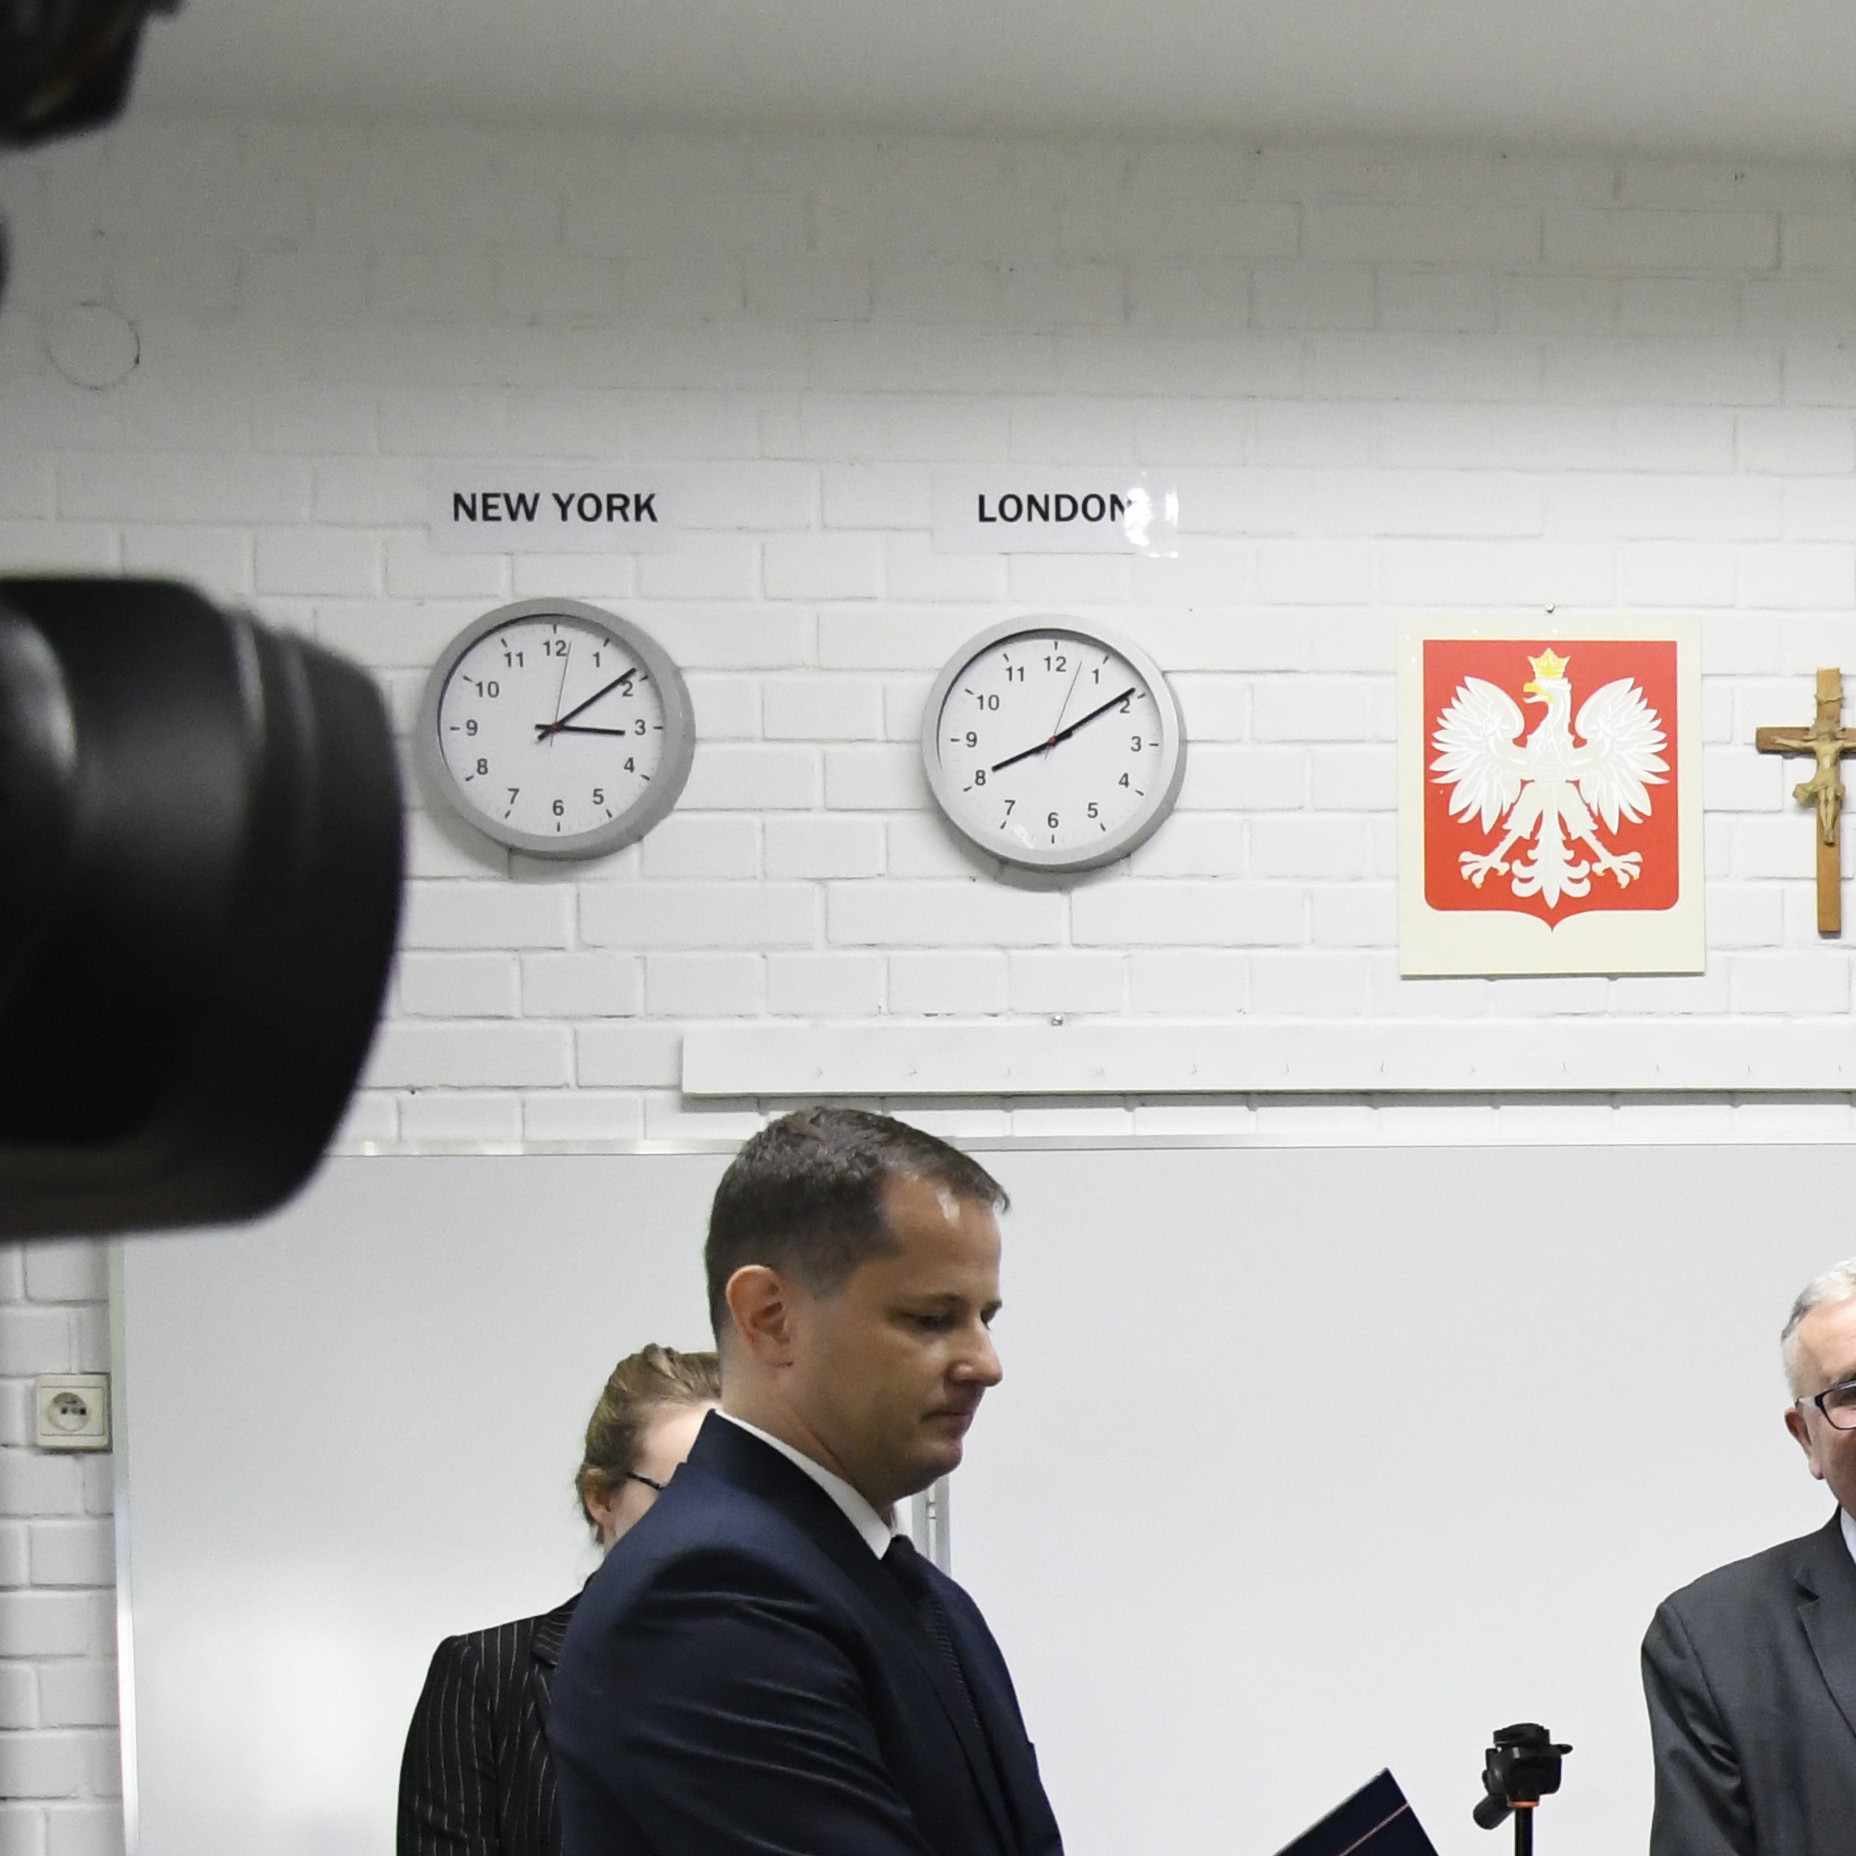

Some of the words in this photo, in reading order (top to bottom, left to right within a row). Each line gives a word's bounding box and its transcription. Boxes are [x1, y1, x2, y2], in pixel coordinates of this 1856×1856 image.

[453, 493, 540, 523] NEW
[553, 493, 658, 523] YORK
[543, 640, 567, 657] 12
[504, 652, 523, 667] 11
[593, 652, 600, 667] 1
[1044, 656, 1066, 672] 12
[1006, 666, 1024, 682] 11
[1092, 669, 1099, 684] 1
[476, 681, 499, 698] 10
[977, 695, 999, 711] 10
[466, 720, 478, 736] 9
[635, 720, 646, 735] 3
[966, 732, 977, 747] 9
[1131, 736, 1141, 752] 3
[476, 758, 488, 775] 8
[624, 758, 634, 773] 4
[975, 770, 986, 786] 8
[1119, 773, 1129, 788] 4
[508, 788, 519, 804] 7
[593, 789, 604, 804] 5
[553, 800, 564, 816] 6
[1004, 800, 1015, 815] 7
[1088, 803, 1098, 818] 5
[1048, 813, 1058, 828] 6
